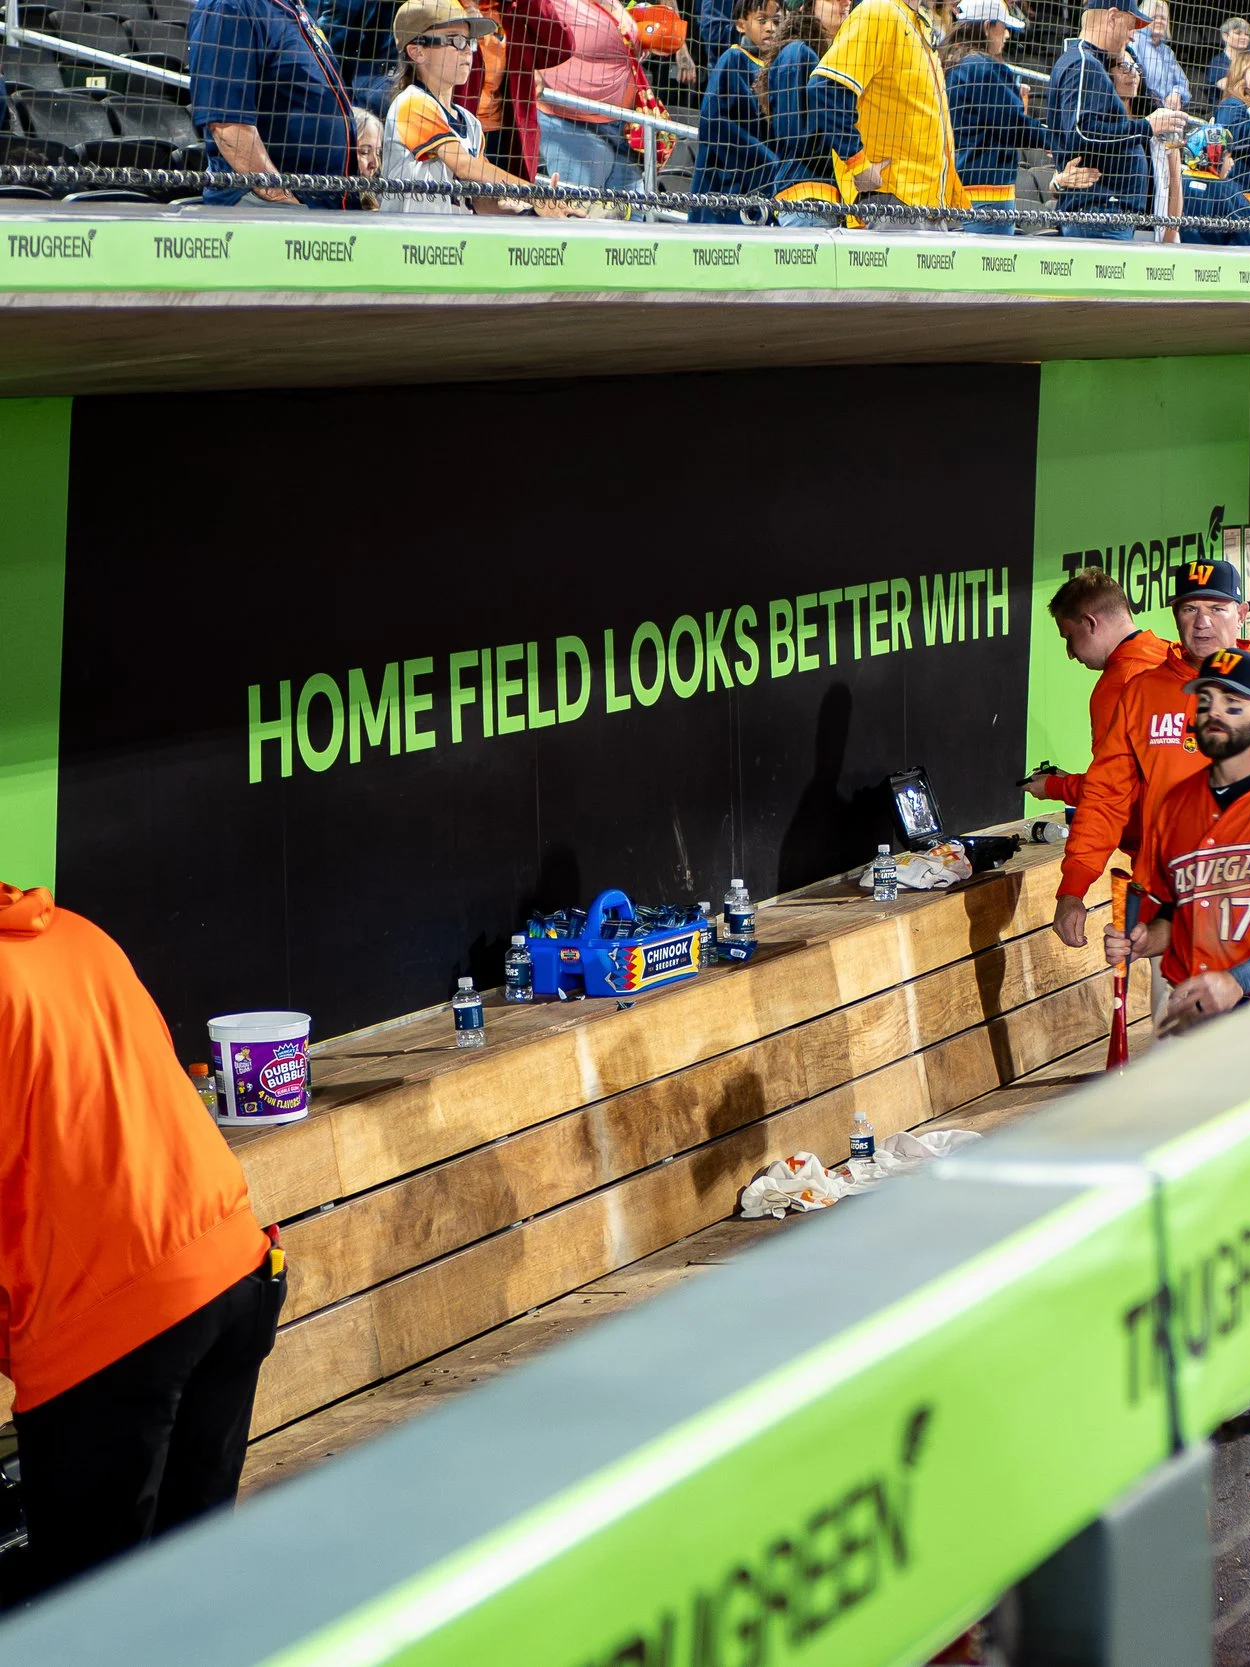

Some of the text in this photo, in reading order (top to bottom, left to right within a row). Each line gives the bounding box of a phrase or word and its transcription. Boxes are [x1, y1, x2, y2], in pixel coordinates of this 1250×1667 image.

[8, 235, 93, 258] TRUGREEN
[154, 236, 229, 259] TRUGREEN
[285, 241, 352, 262] TRUGREEN
[402, 246, 463, 265] TRUGREEN
[508, 247, 563, 266] TRUGREEN
[605, 247, 655, 266] TRUGREEN
[693, 247, 738, 266] TRUGREEN
[774, 248, 815, 265] TRUGREEN
[849, 251, 888, 267] TRUGREEN
[917, 254, 954, 270] TRUGREEN
[982, 257, 1015, 272] TRUGREEN
[1040, 261, 1072, 276] TRUGREEN
[1095, 265, 1124, 279] TRUGREEN
[1146, 267, 1173, 281] TRUGREEN
[1194, 269, 1219, 282] TRUGREEN
[1188, 561, 1214, 585] LV
[1210, 648, 1243, 675] LV
[249, 567, 1009, 784] HOME FIELD LOOKS BETTER WITH
[1150, 713, 1185, 738] LAS
[647, 940, 689, 964] CHINOOK
[655, 958, 680, 972] SEEDERY
[264, 1058, 304, 1079] DUBBLE
[267, 1068, 305, 1089] BUBBLE
